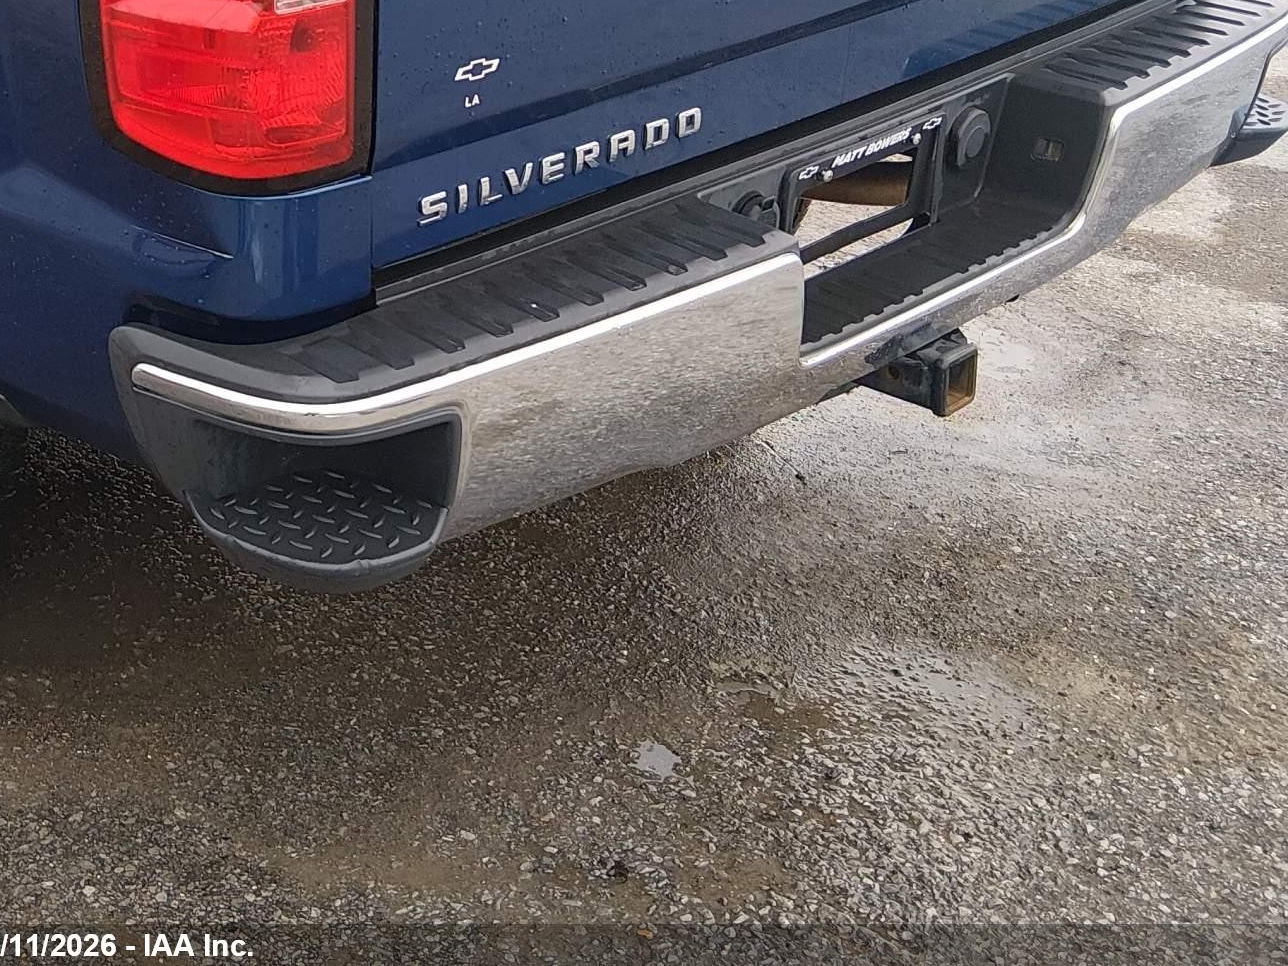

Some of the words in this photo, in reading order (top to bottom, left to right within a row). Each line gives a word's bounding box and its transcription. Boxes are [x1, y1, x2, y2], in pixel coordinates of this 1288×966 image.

[464, 93, 481, 108] LA
[417, 107, 702, 226] SILVERADO
[832, 145, 867, 168] MATT
[865, 127, 912, 156] BOWERS
